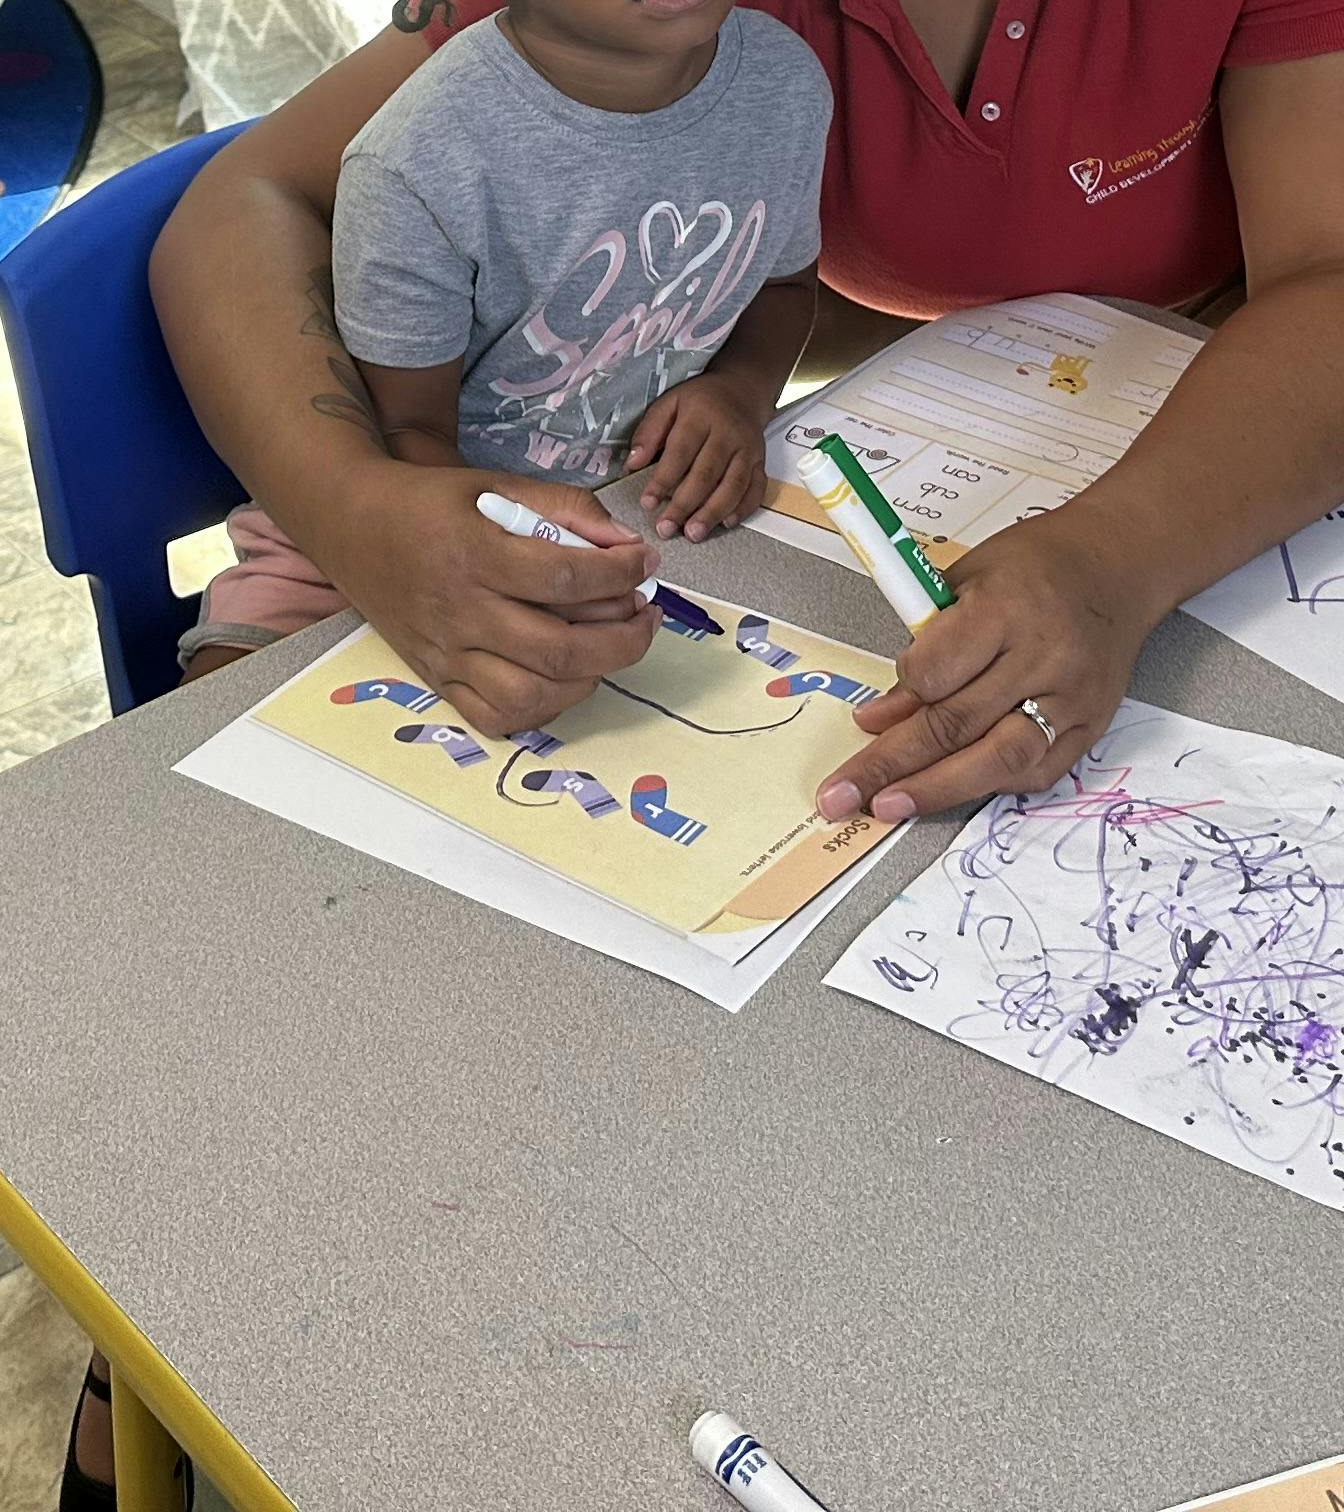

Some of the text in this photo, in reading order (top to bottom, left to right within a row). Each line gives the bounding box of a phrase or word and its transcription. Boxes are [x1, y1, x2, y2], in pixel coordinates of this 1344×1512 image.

[1085, 184, 1118, 205] CHILD
[941, 463, 981, 484] can
[919, 481, 960, 502] cub
[892, 496, 943, 521] corn
[536, 521, 560, 542] AP
[822, 817, 871, 853] Socks
